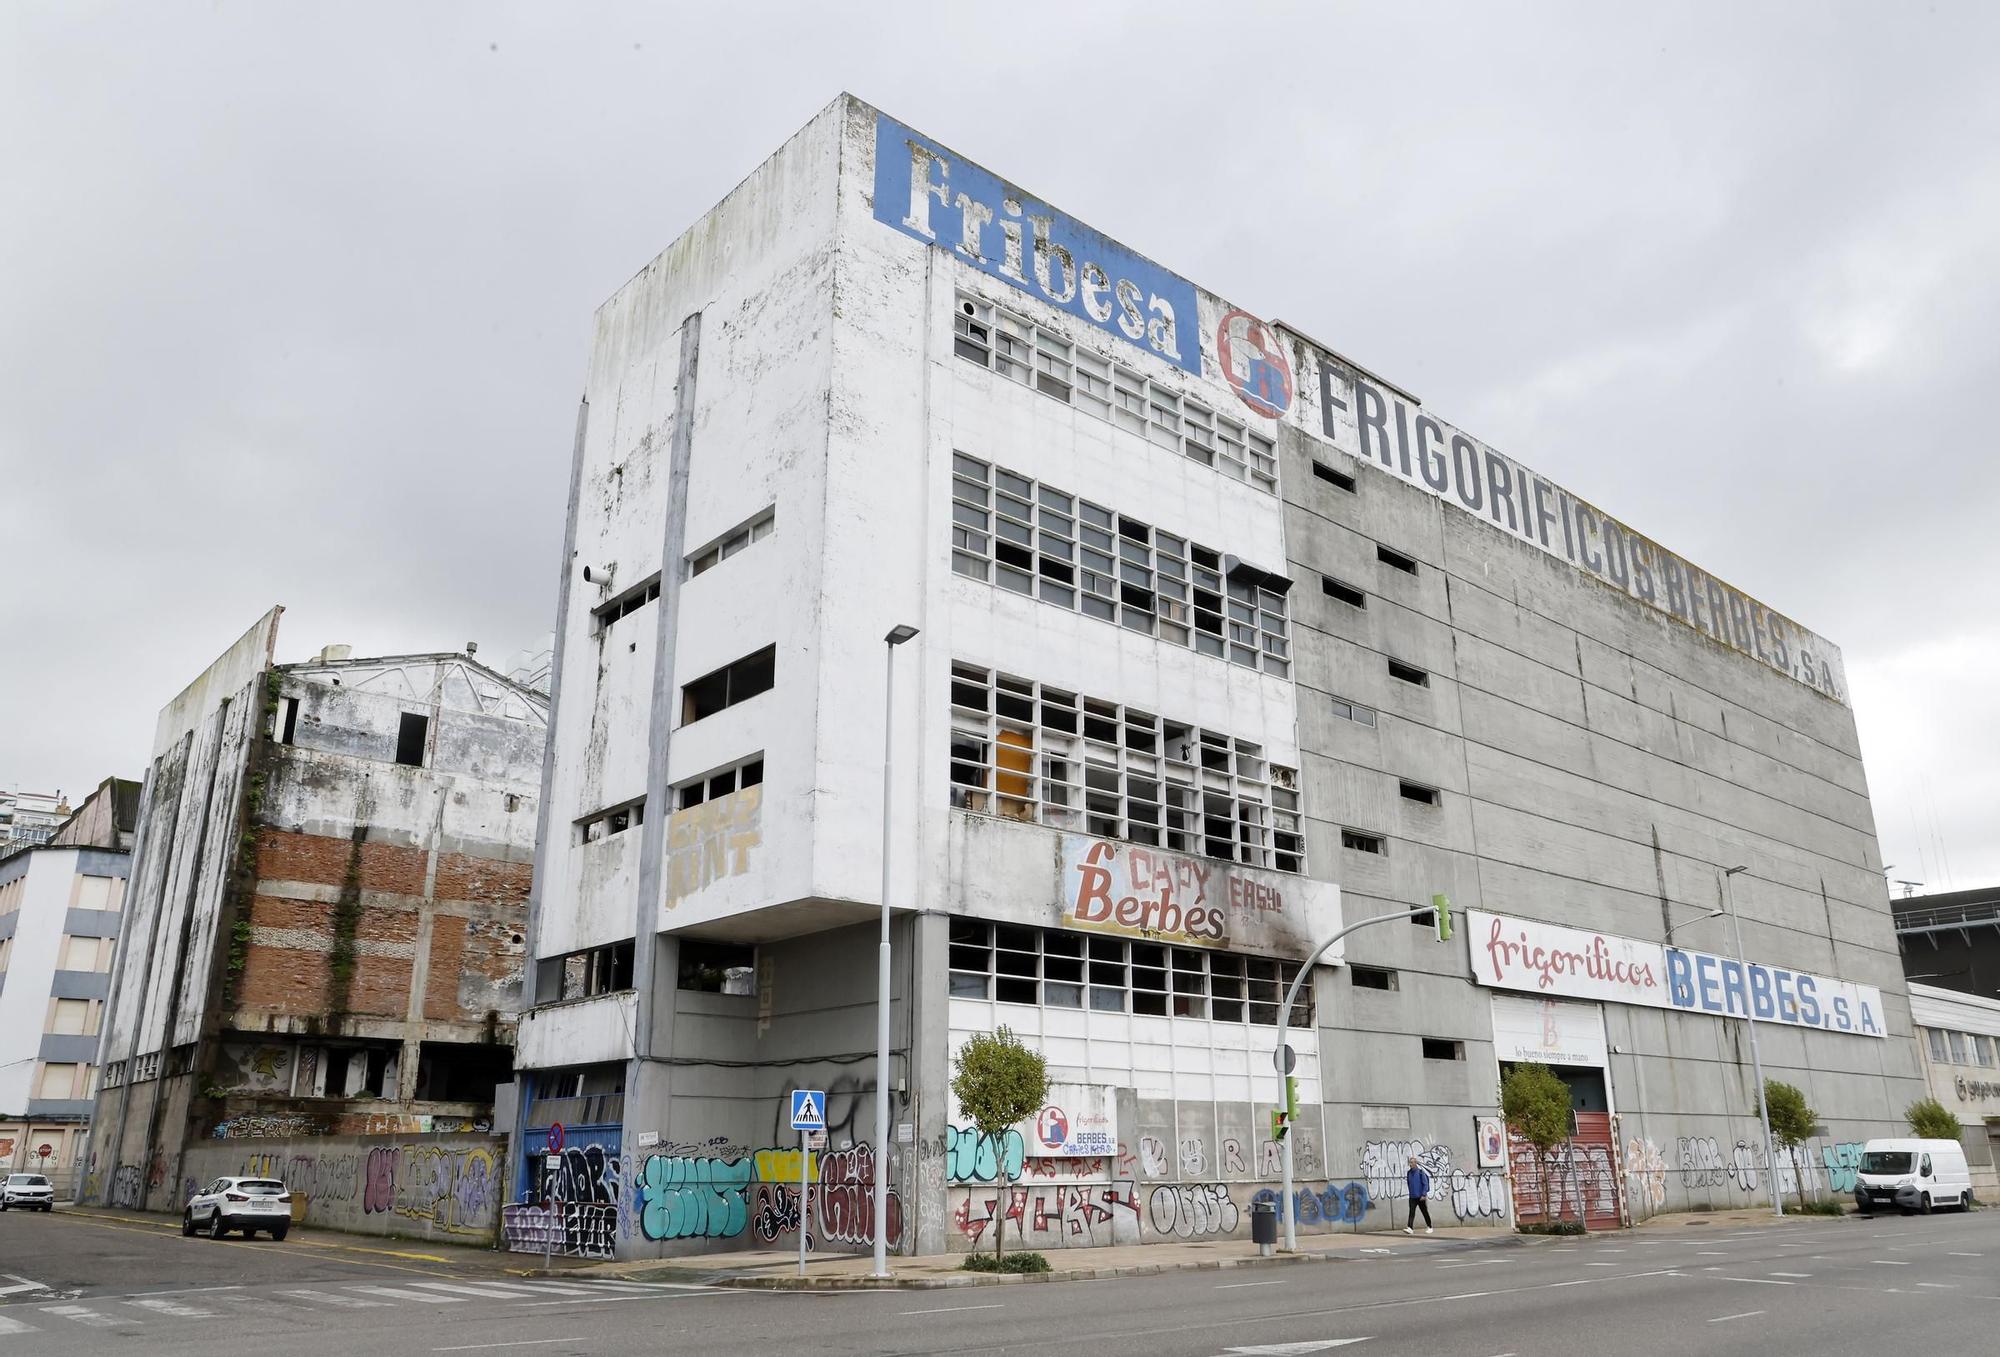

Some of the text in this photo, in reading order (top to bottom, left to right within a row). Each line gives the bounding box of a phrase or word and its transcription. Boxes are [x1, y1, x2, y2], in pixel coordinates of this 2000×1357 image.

[902, 138, 1182, 362] Fribesa
[1319, 363, 1656, 602] FRIGORIFICOS
[1073, 842, 1225, 940] Berbés
